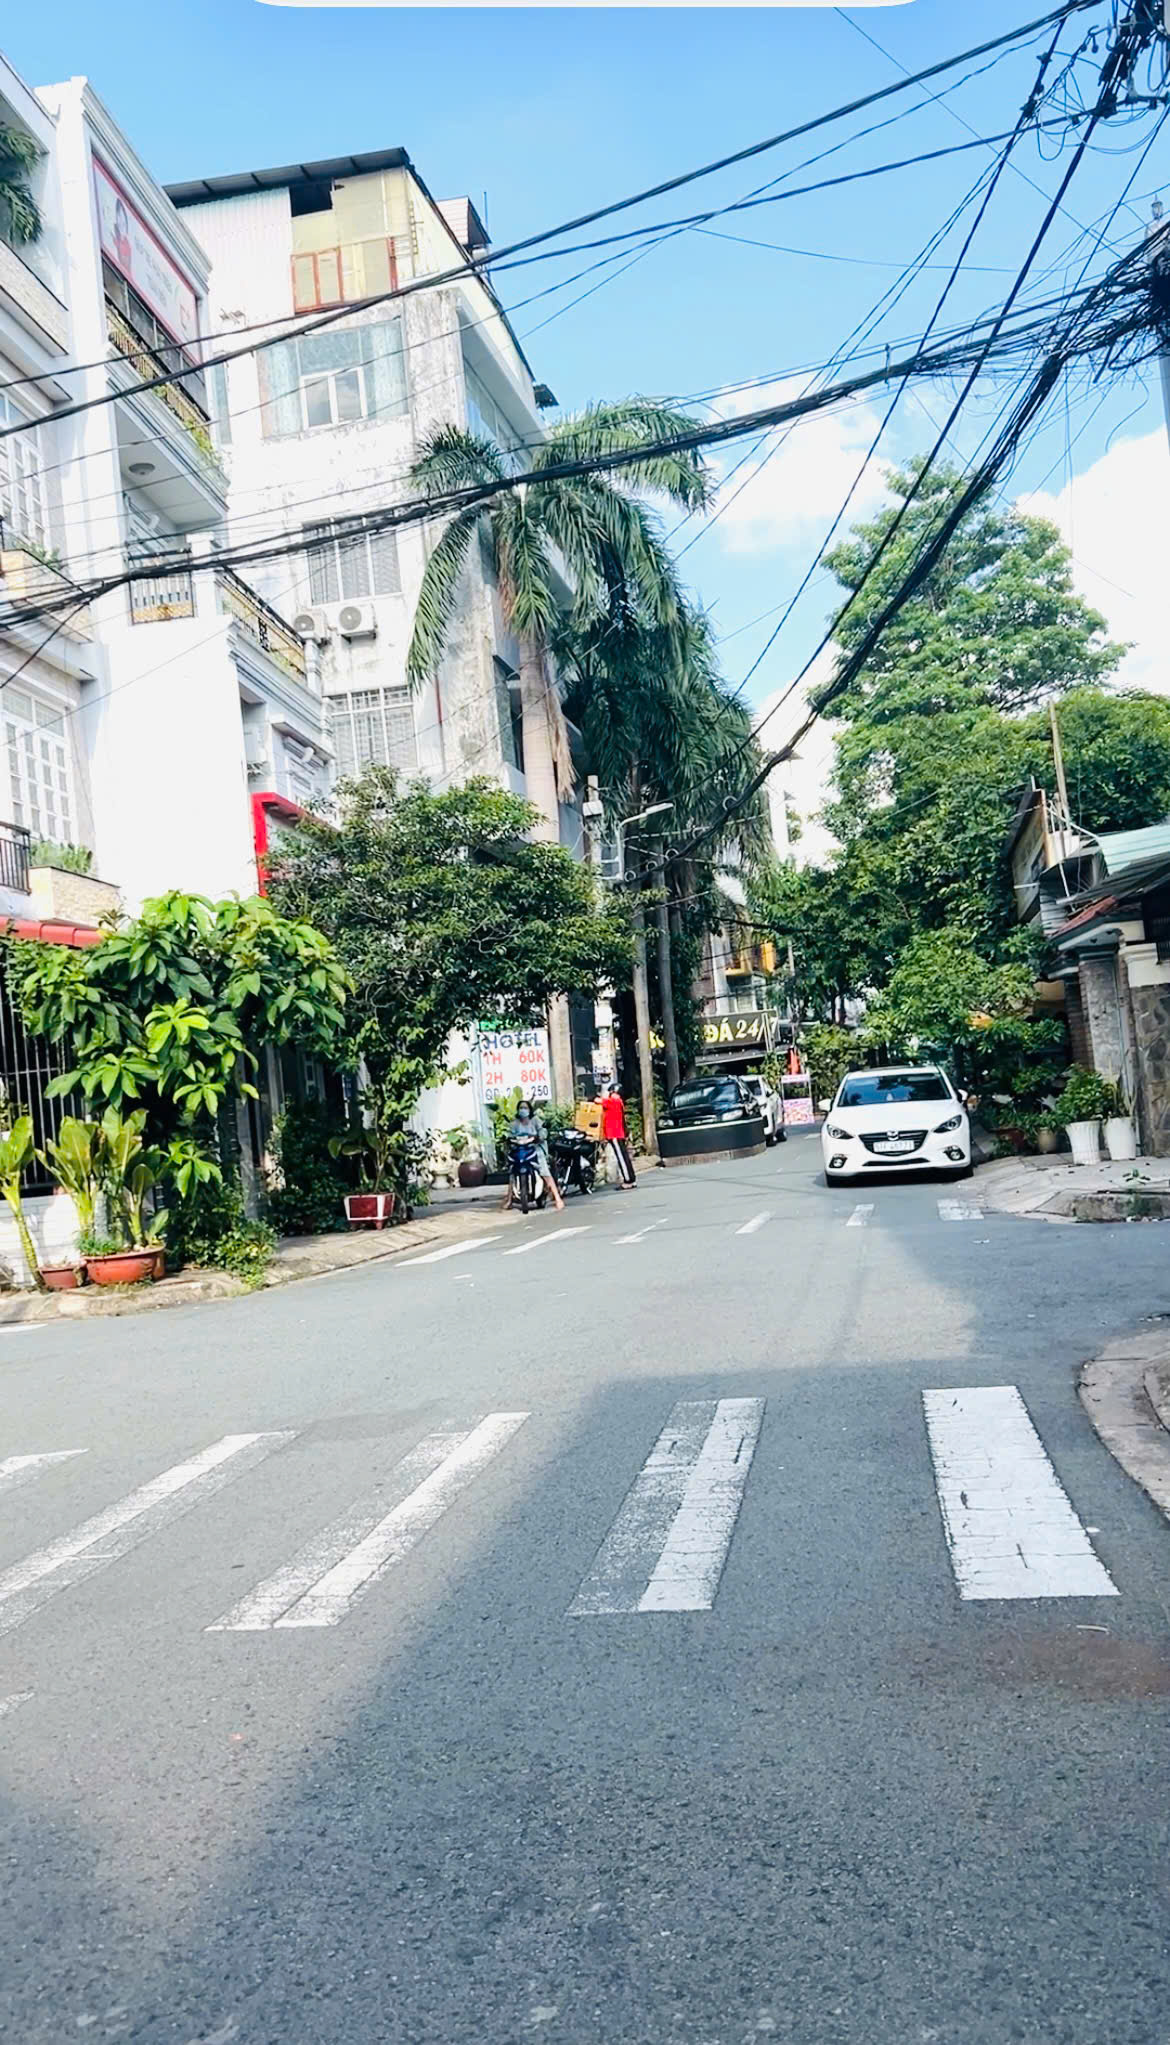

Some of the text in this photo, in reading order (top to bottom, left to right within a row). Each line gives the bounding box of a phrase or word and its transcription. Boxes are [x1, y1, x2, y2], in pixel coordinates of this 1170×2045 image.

[703, 1016, 779, 1042] ĐÁ 24/7
[484, 1032, 542, 1049] HOTEL
[484, 1049, 545, 1065] 1H 60K
[485, 1068, 546, 1085] 2H 80K
